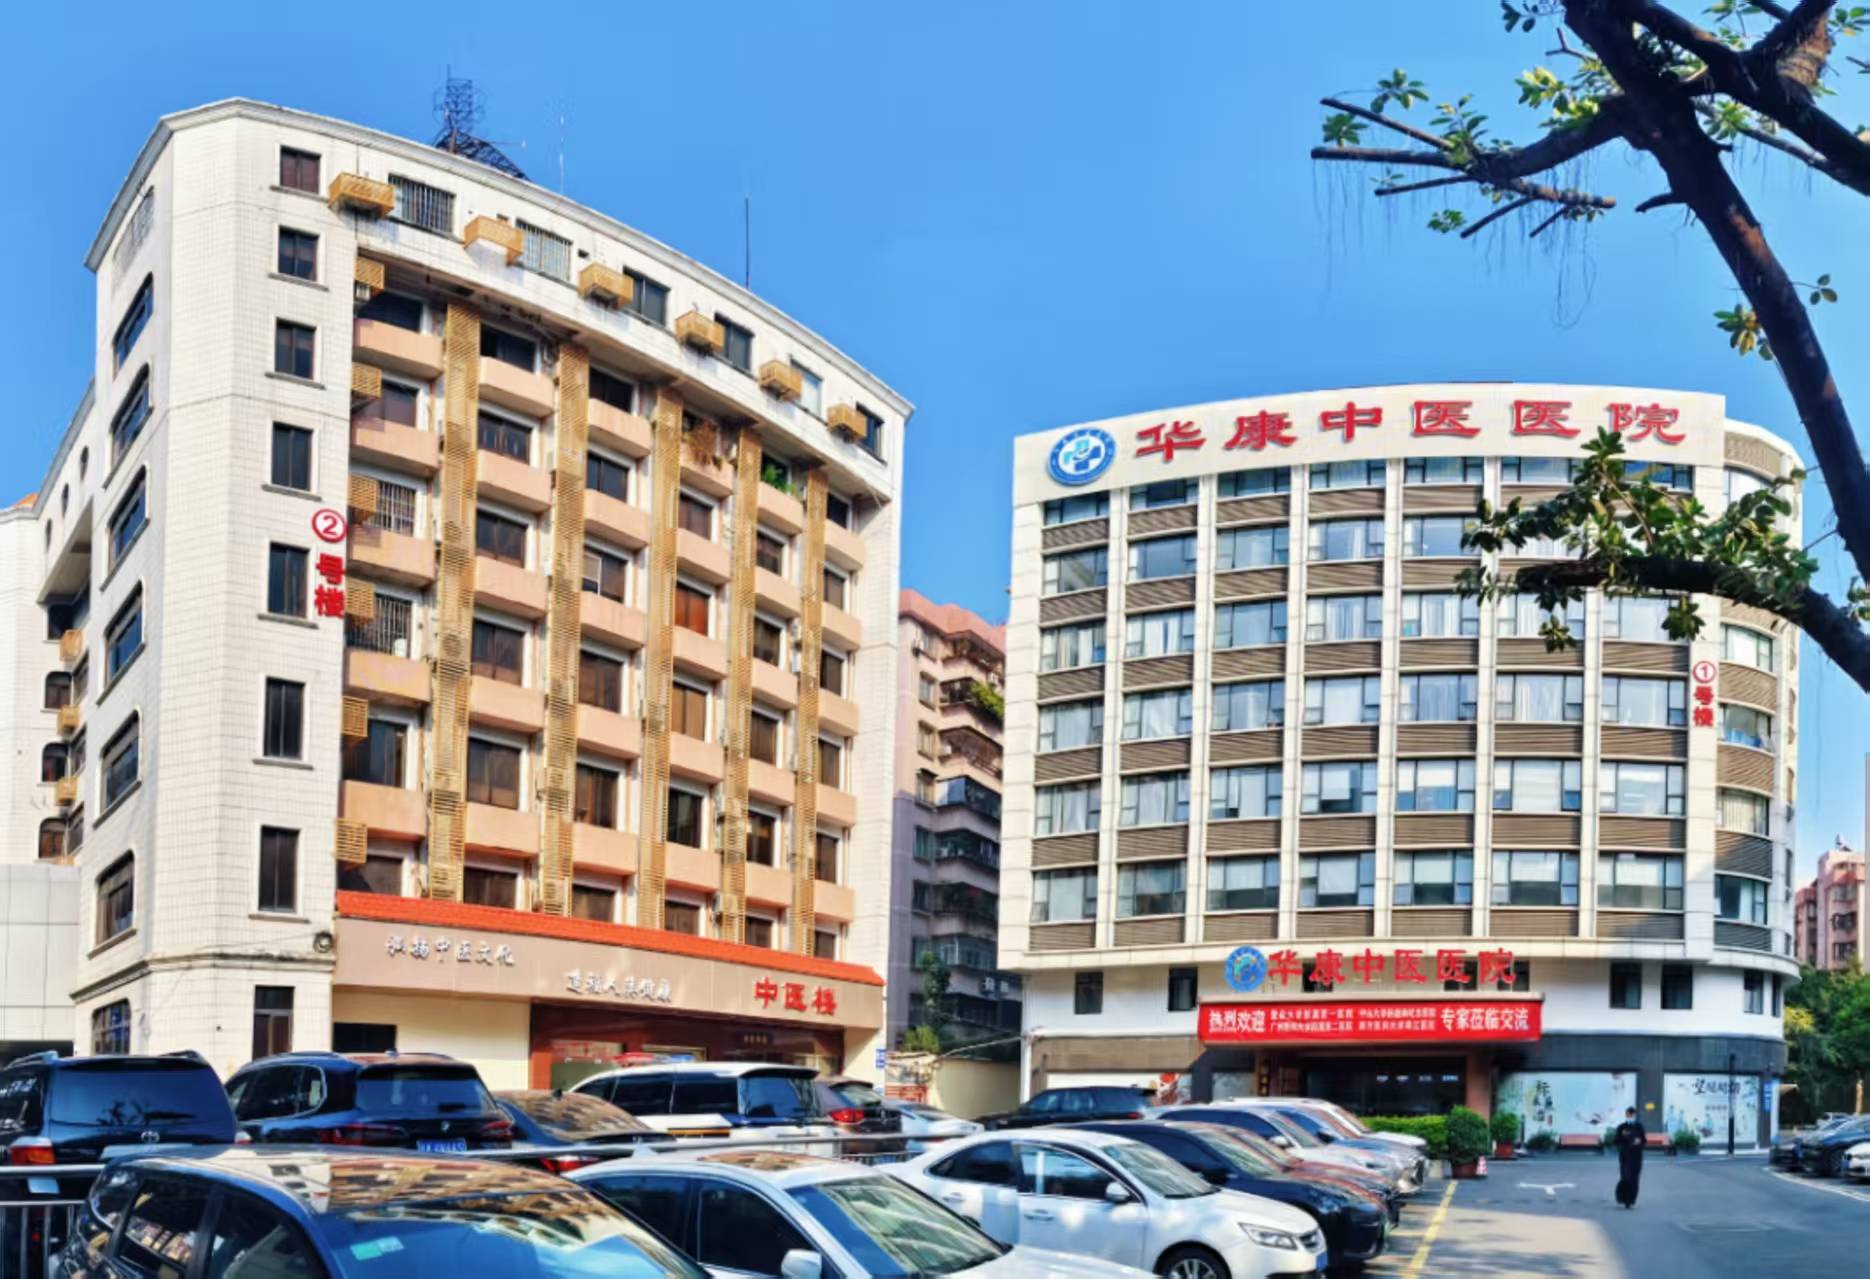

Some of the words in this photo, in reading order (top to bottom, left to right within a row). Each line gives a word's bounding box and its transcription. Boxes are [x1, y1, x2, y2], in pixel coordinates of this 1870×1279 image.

[1136, 400, 1686, 462] 华康中医医院
[1267, 948, 1517, 987] 华康中医医院
[755, 976, 838, 1016] 中医楼
[1209, 1009, 1265, 1033] 热烈欢迎
[1441, 1008, 1529, 1032] 专家莅临交流
